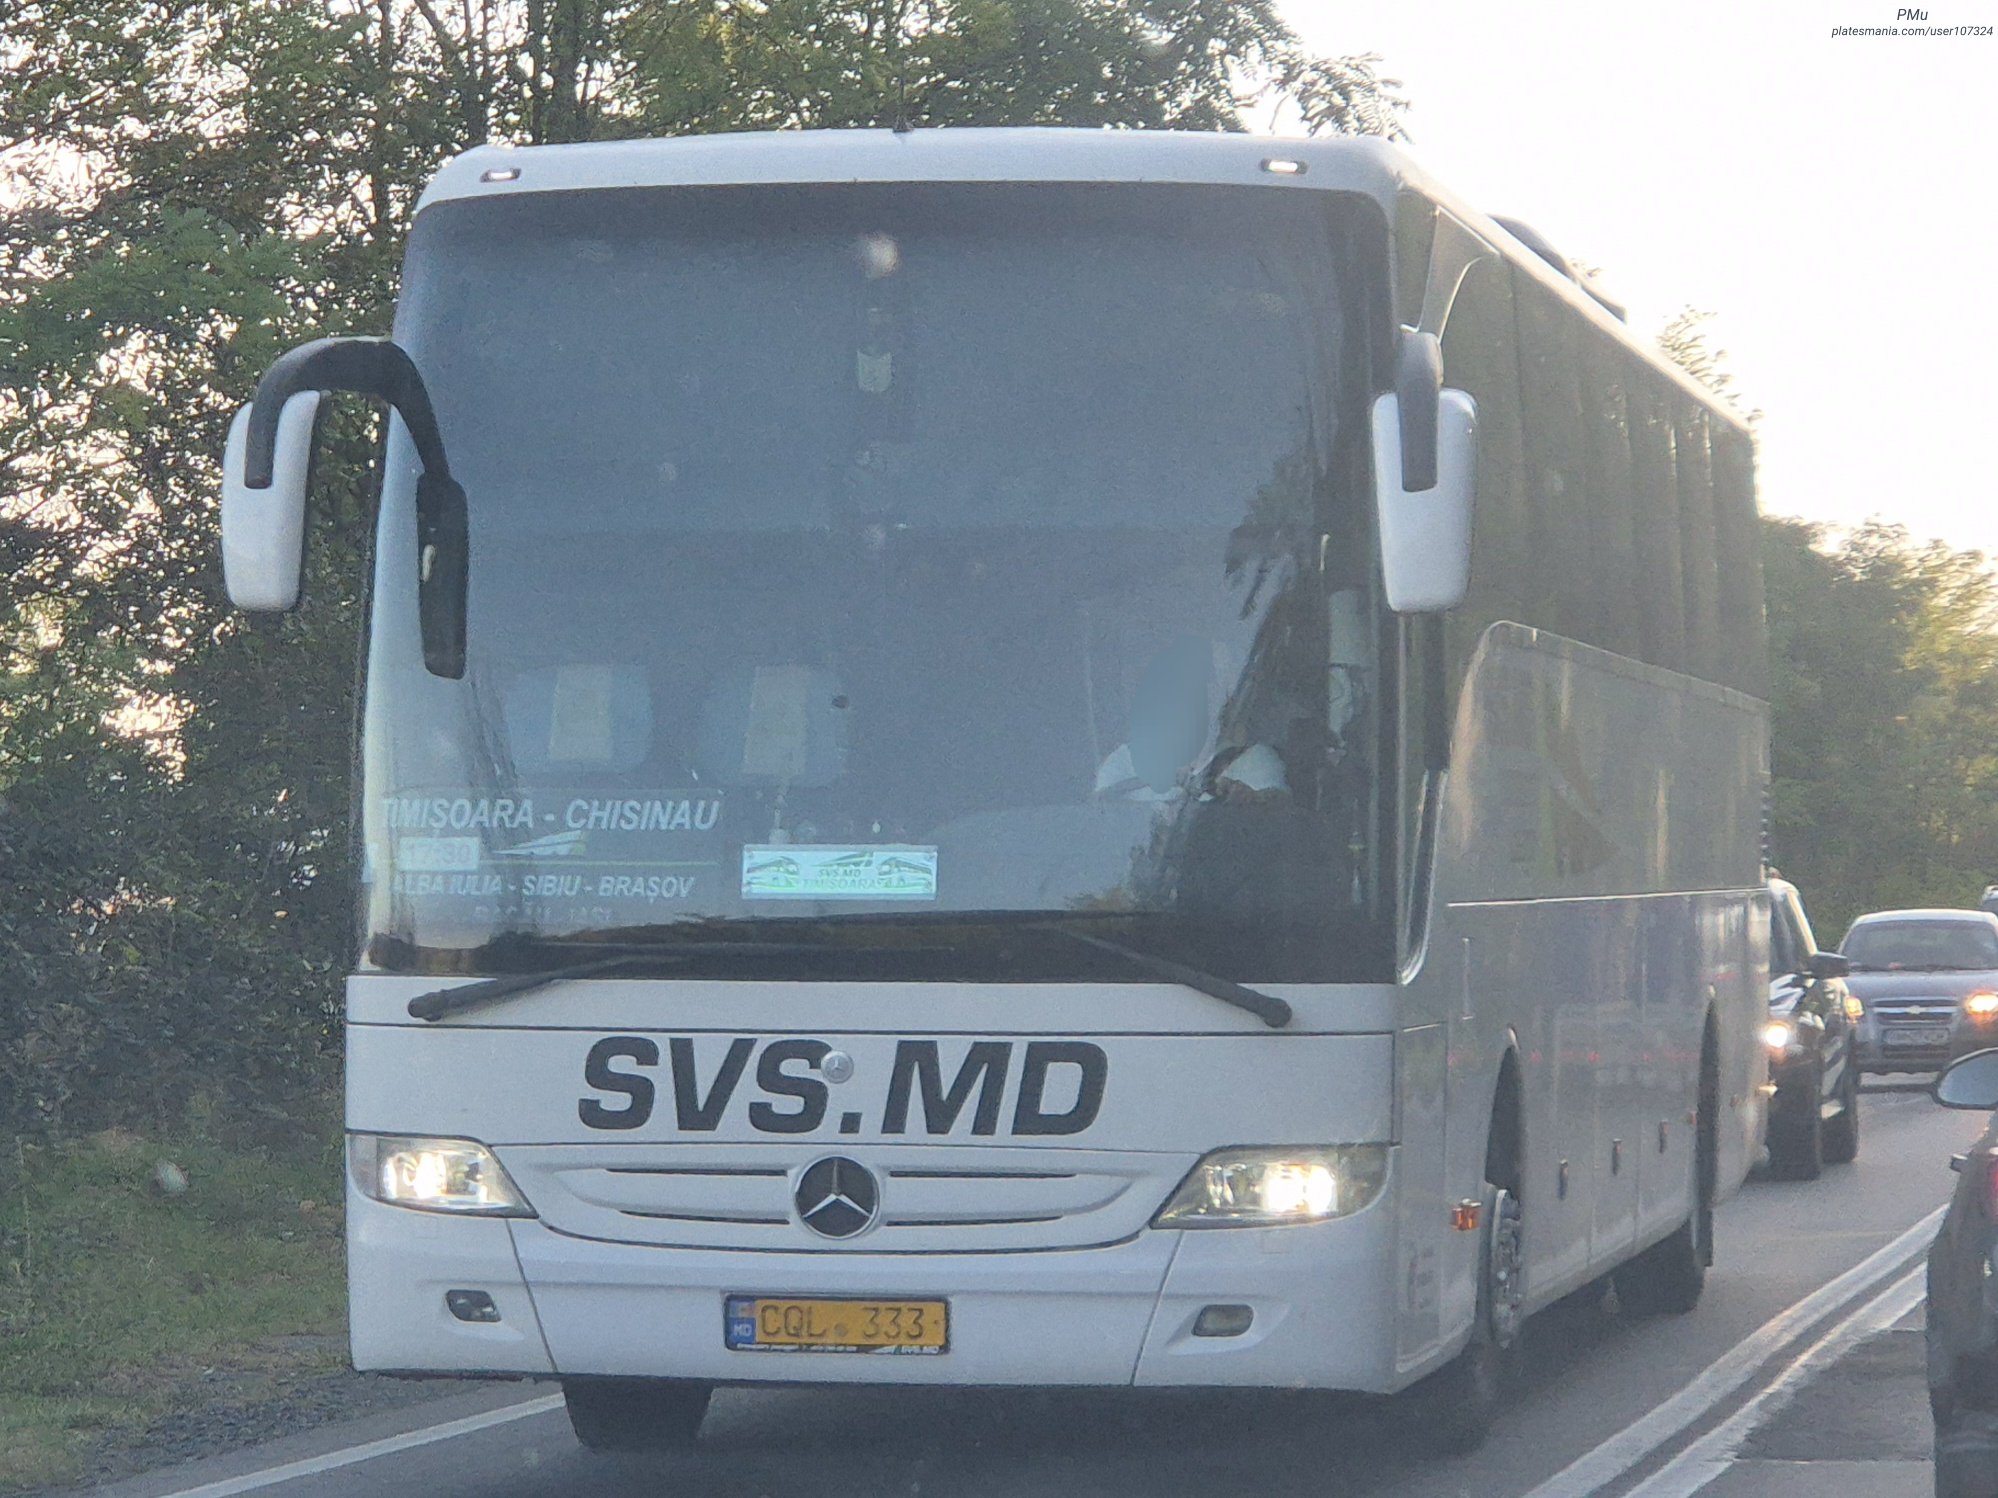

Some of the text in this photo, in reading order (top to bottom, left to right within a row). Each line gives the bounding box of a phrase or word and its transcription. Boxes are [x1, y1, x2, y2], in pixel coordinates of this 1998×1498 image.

[565, 799, 719, 831] CHISINAU
[391, 874, 445, 897] ALBA
[522, 875, 582, 897] SIBIU
[578, 1036, 1108, 1136] SVS.MD
[733, 1304, 925, 1340] MD CQL 333
